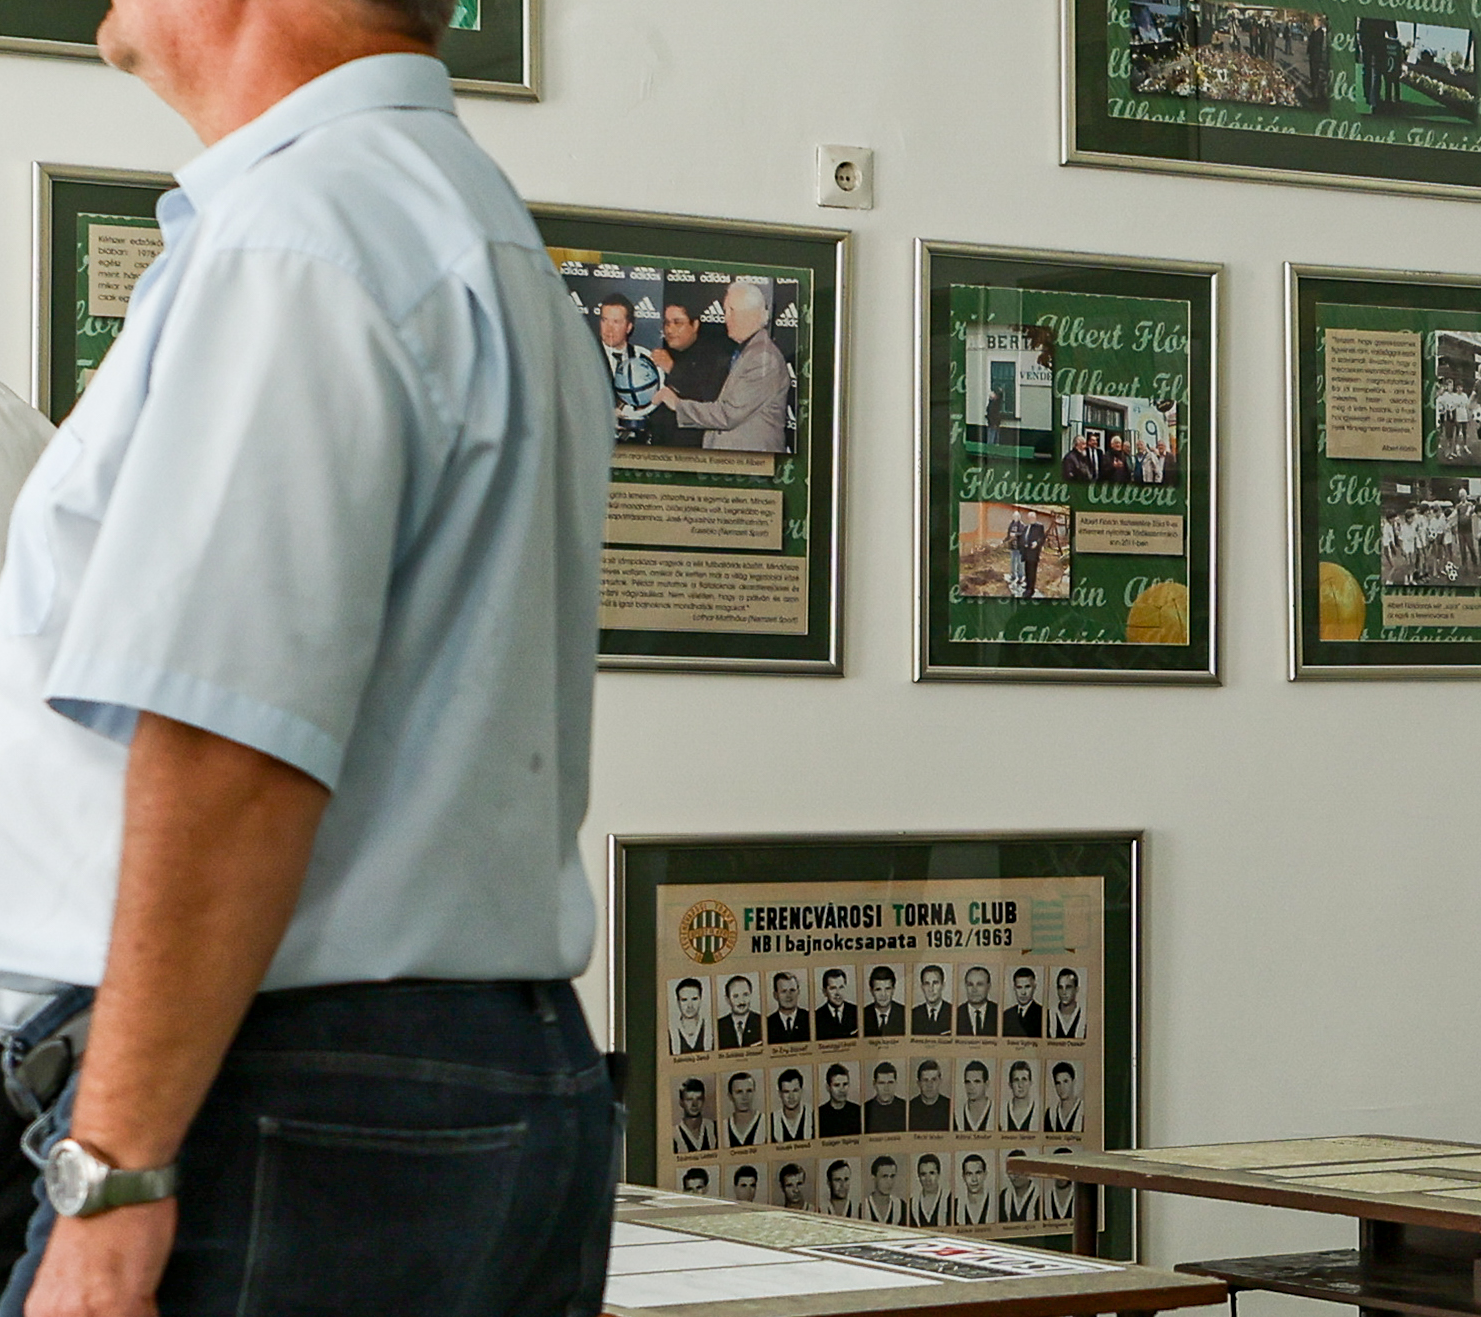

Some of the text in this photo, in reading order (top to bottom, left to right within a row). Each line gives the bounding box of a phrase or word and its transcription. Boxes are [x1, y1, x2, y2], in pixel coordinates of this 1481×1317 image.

[593, 268, 625, 279] adidas
[629, 270, 661, 281] adidas
[666, 272, 696, 283] adidas
[700, 274, 731, 284] adidas
[960, 466, 1071, 502] Flórián
[743, 900, 1018, 931] FERENCVÁROSI TORNA CLUB
[751, 935, 773, 954] NB
[786, 932, 917, 956] bajnokcsapata
[926, 928, 1013, 949] 1962/1963
